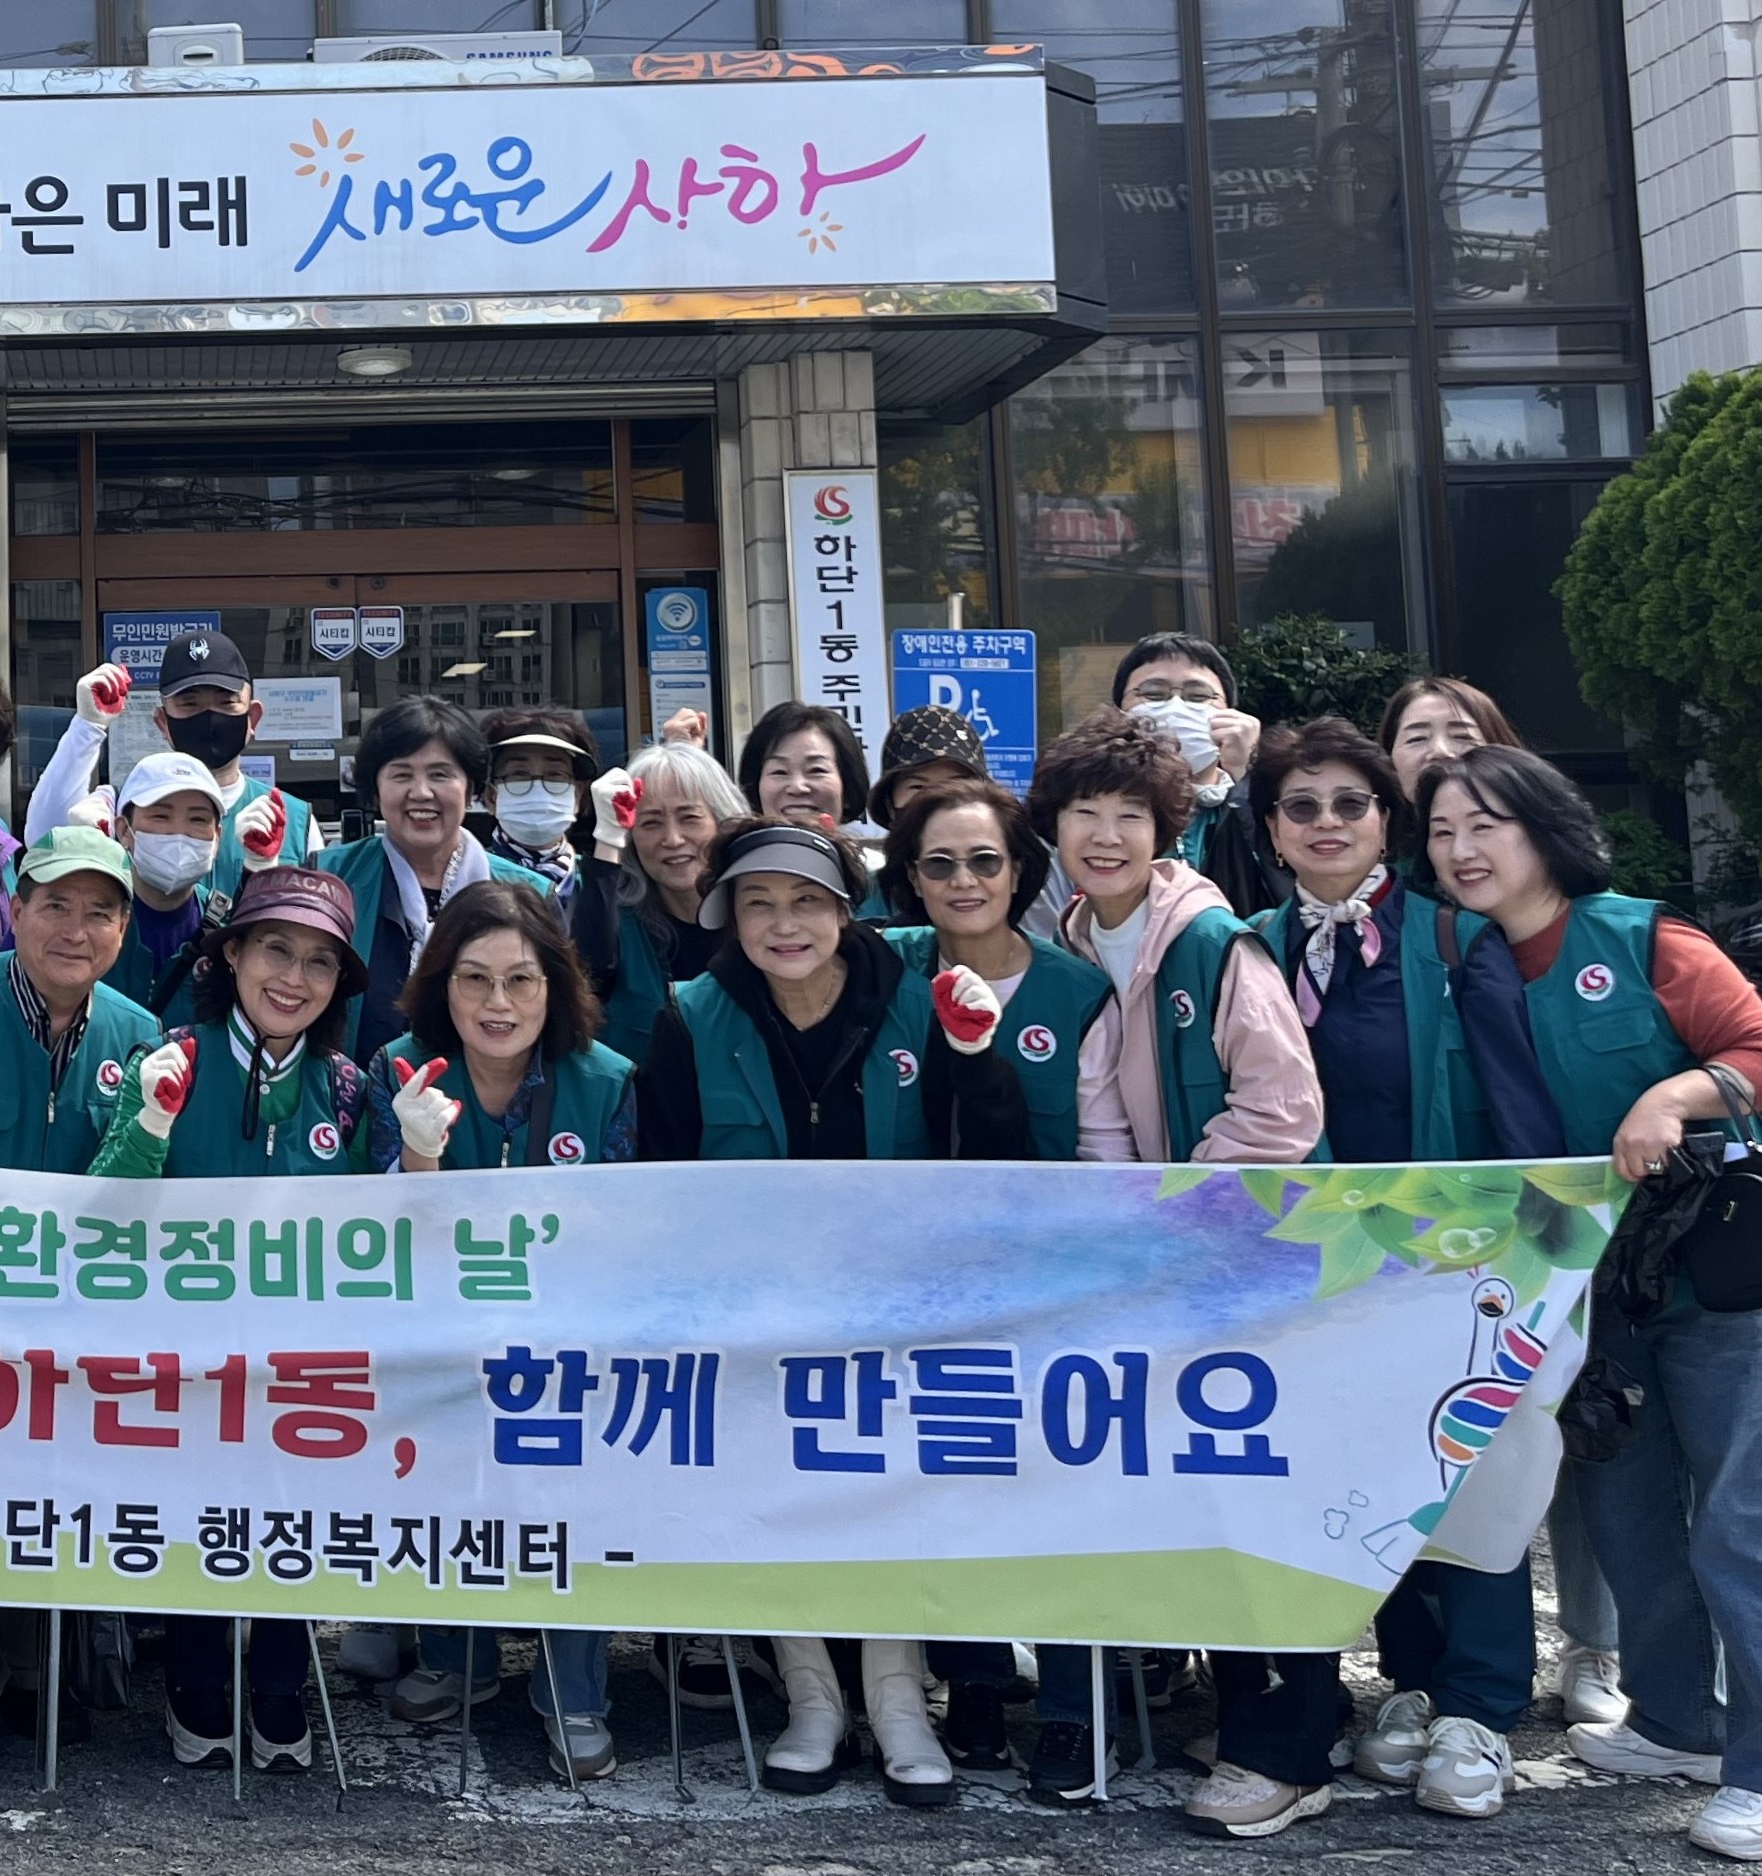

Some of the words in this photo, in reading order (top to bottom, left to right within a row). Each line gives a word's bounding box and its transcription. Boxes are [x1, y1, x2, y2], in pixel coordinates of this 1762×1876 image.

[106, 175, 248, 249] 미래
[293, 136, 613, 272] 새로운
[586, 133, 927, 253] 사하
[813, 534, 860, 664] 하단1동
[119, 649, 163, 664] 운영시간
[319, 627, 350, 639] 시티캅
[365, 626, 396, 637] 시티캅
[901, 634, 968, 655] 장애인전용
[972, 635, 1027, 655] 주차구역
[134, 671, 154, 680] CCTV
[453, 1212, 561, 1302] 날’
[481, 1345, 722, 1468] 함께
[782, 1348, 1290, 1477] 만들어요
[197, 1505, 571, 1591] 행정복지센터
